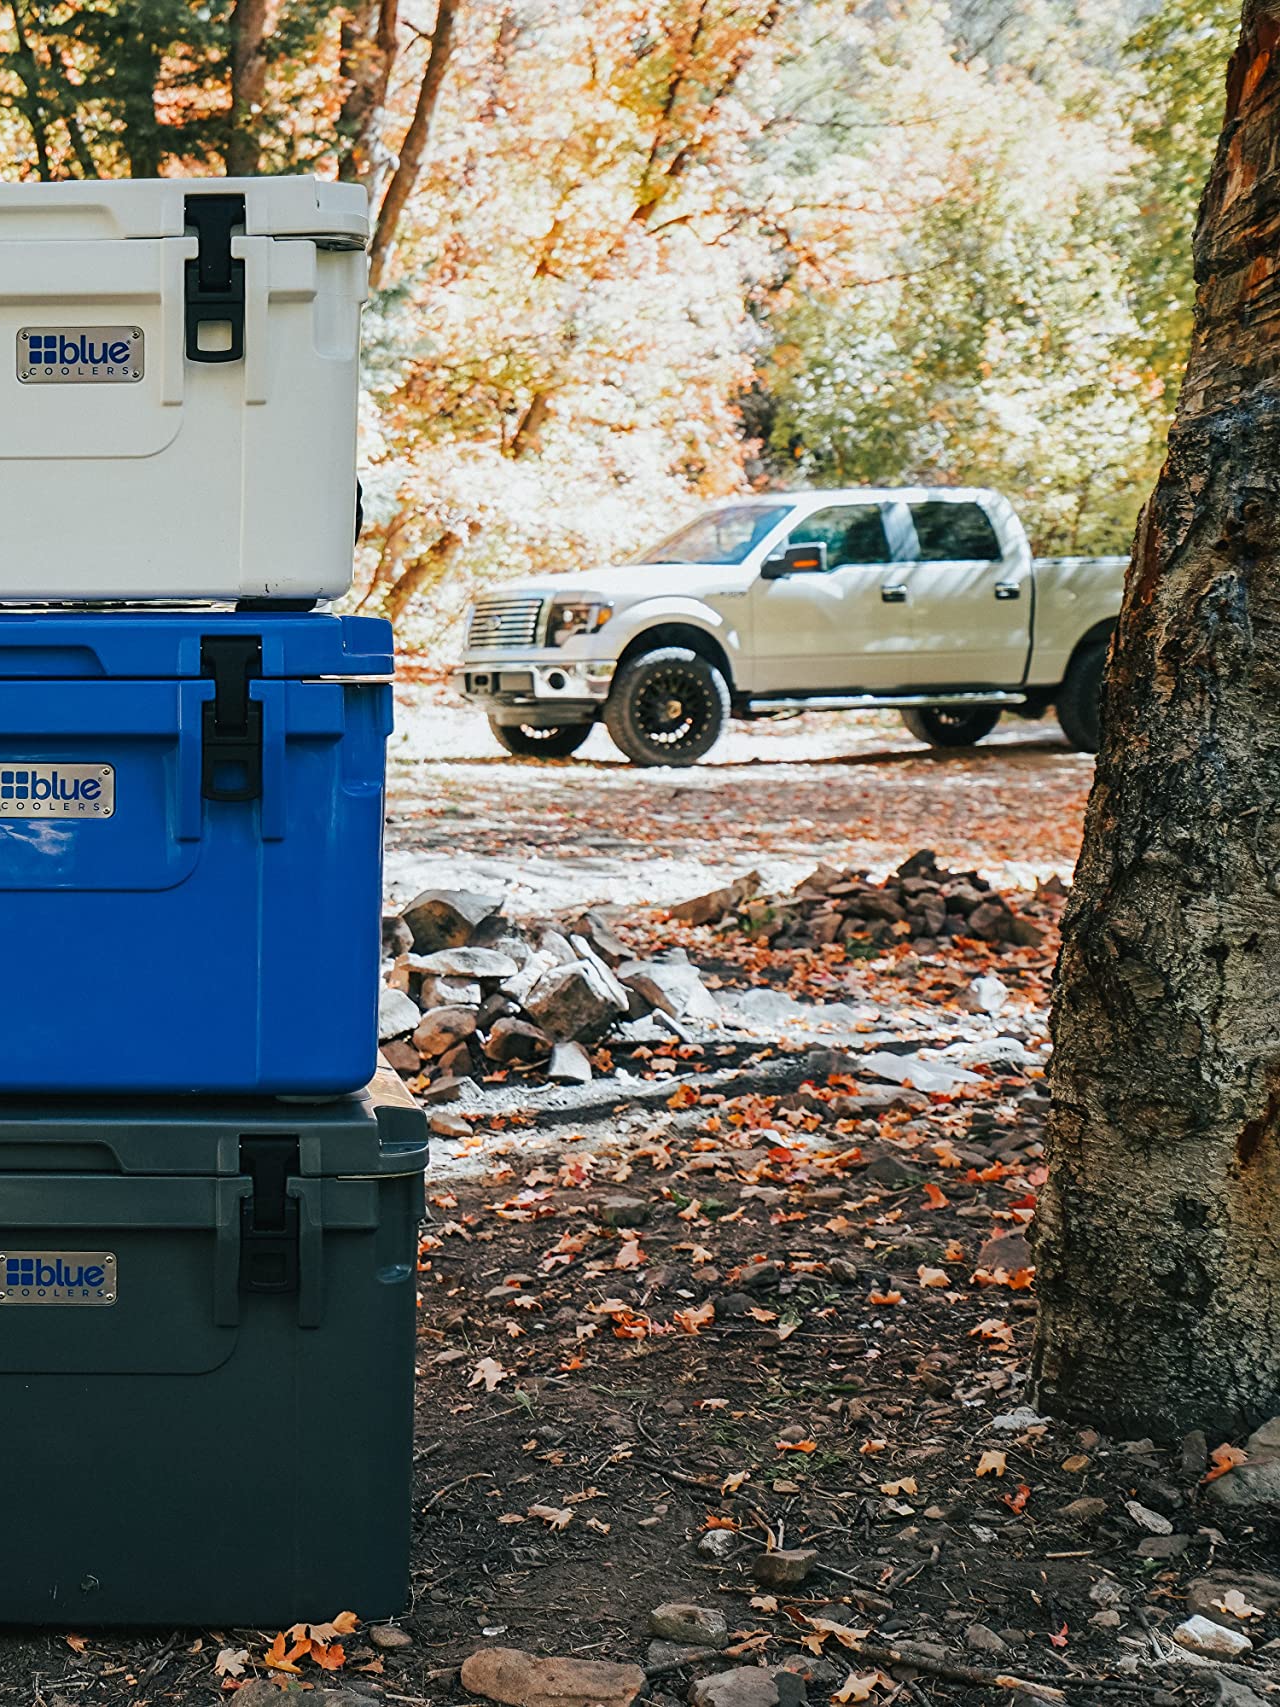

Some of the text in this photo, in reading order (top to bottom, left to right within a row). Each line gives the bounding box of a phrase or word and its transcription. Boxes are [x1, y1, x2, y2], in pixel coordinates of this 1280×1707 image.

[59, 334, 131, 365] blue
[29, 366, 129, 376] COOLERS
[30, 770, 102, 801] blue
[0, 801, 101, 811] COOLERS
[35, 1258, 105, 1287] blue
[6, 1288, 105, 1298] COOLERS
